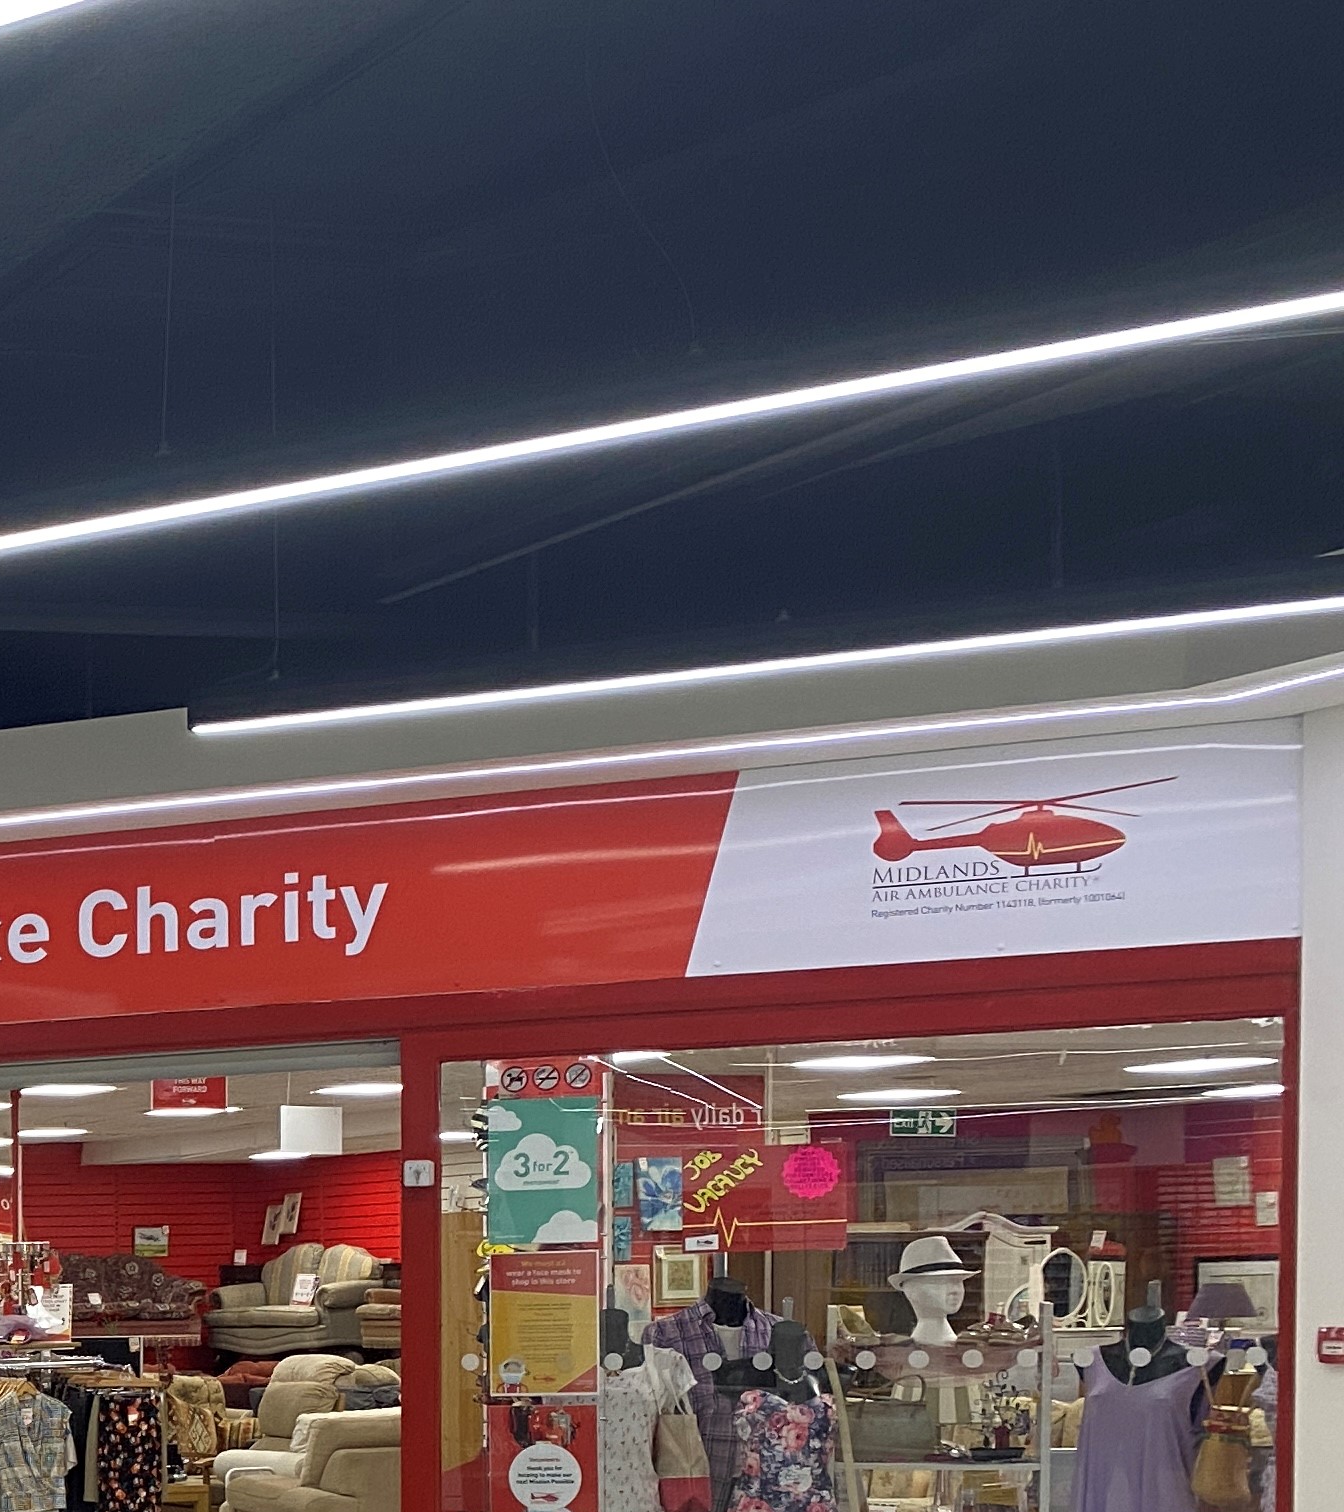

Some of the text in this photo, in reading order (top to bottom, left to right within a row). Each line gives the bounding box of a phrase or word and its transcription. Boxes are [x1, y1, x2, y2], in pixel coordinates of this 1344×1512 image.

[872, 859, 1001, 885] MIDLANDS
[872, 889, 900, 903] AIR
[906, 881, 1009, 901] AMBULANCE
[77, 872, 390, 960] Charity
[872, 905, 919, 919] Registered
[921, 903, 953, 915] Charity
[955, 901, 994, 912] Number
[513, 1150, 570, 1178] 3 for 2
[684, 1150, 723, 1181] JOB
[683, 1149, 764, 1215] VACANCY
